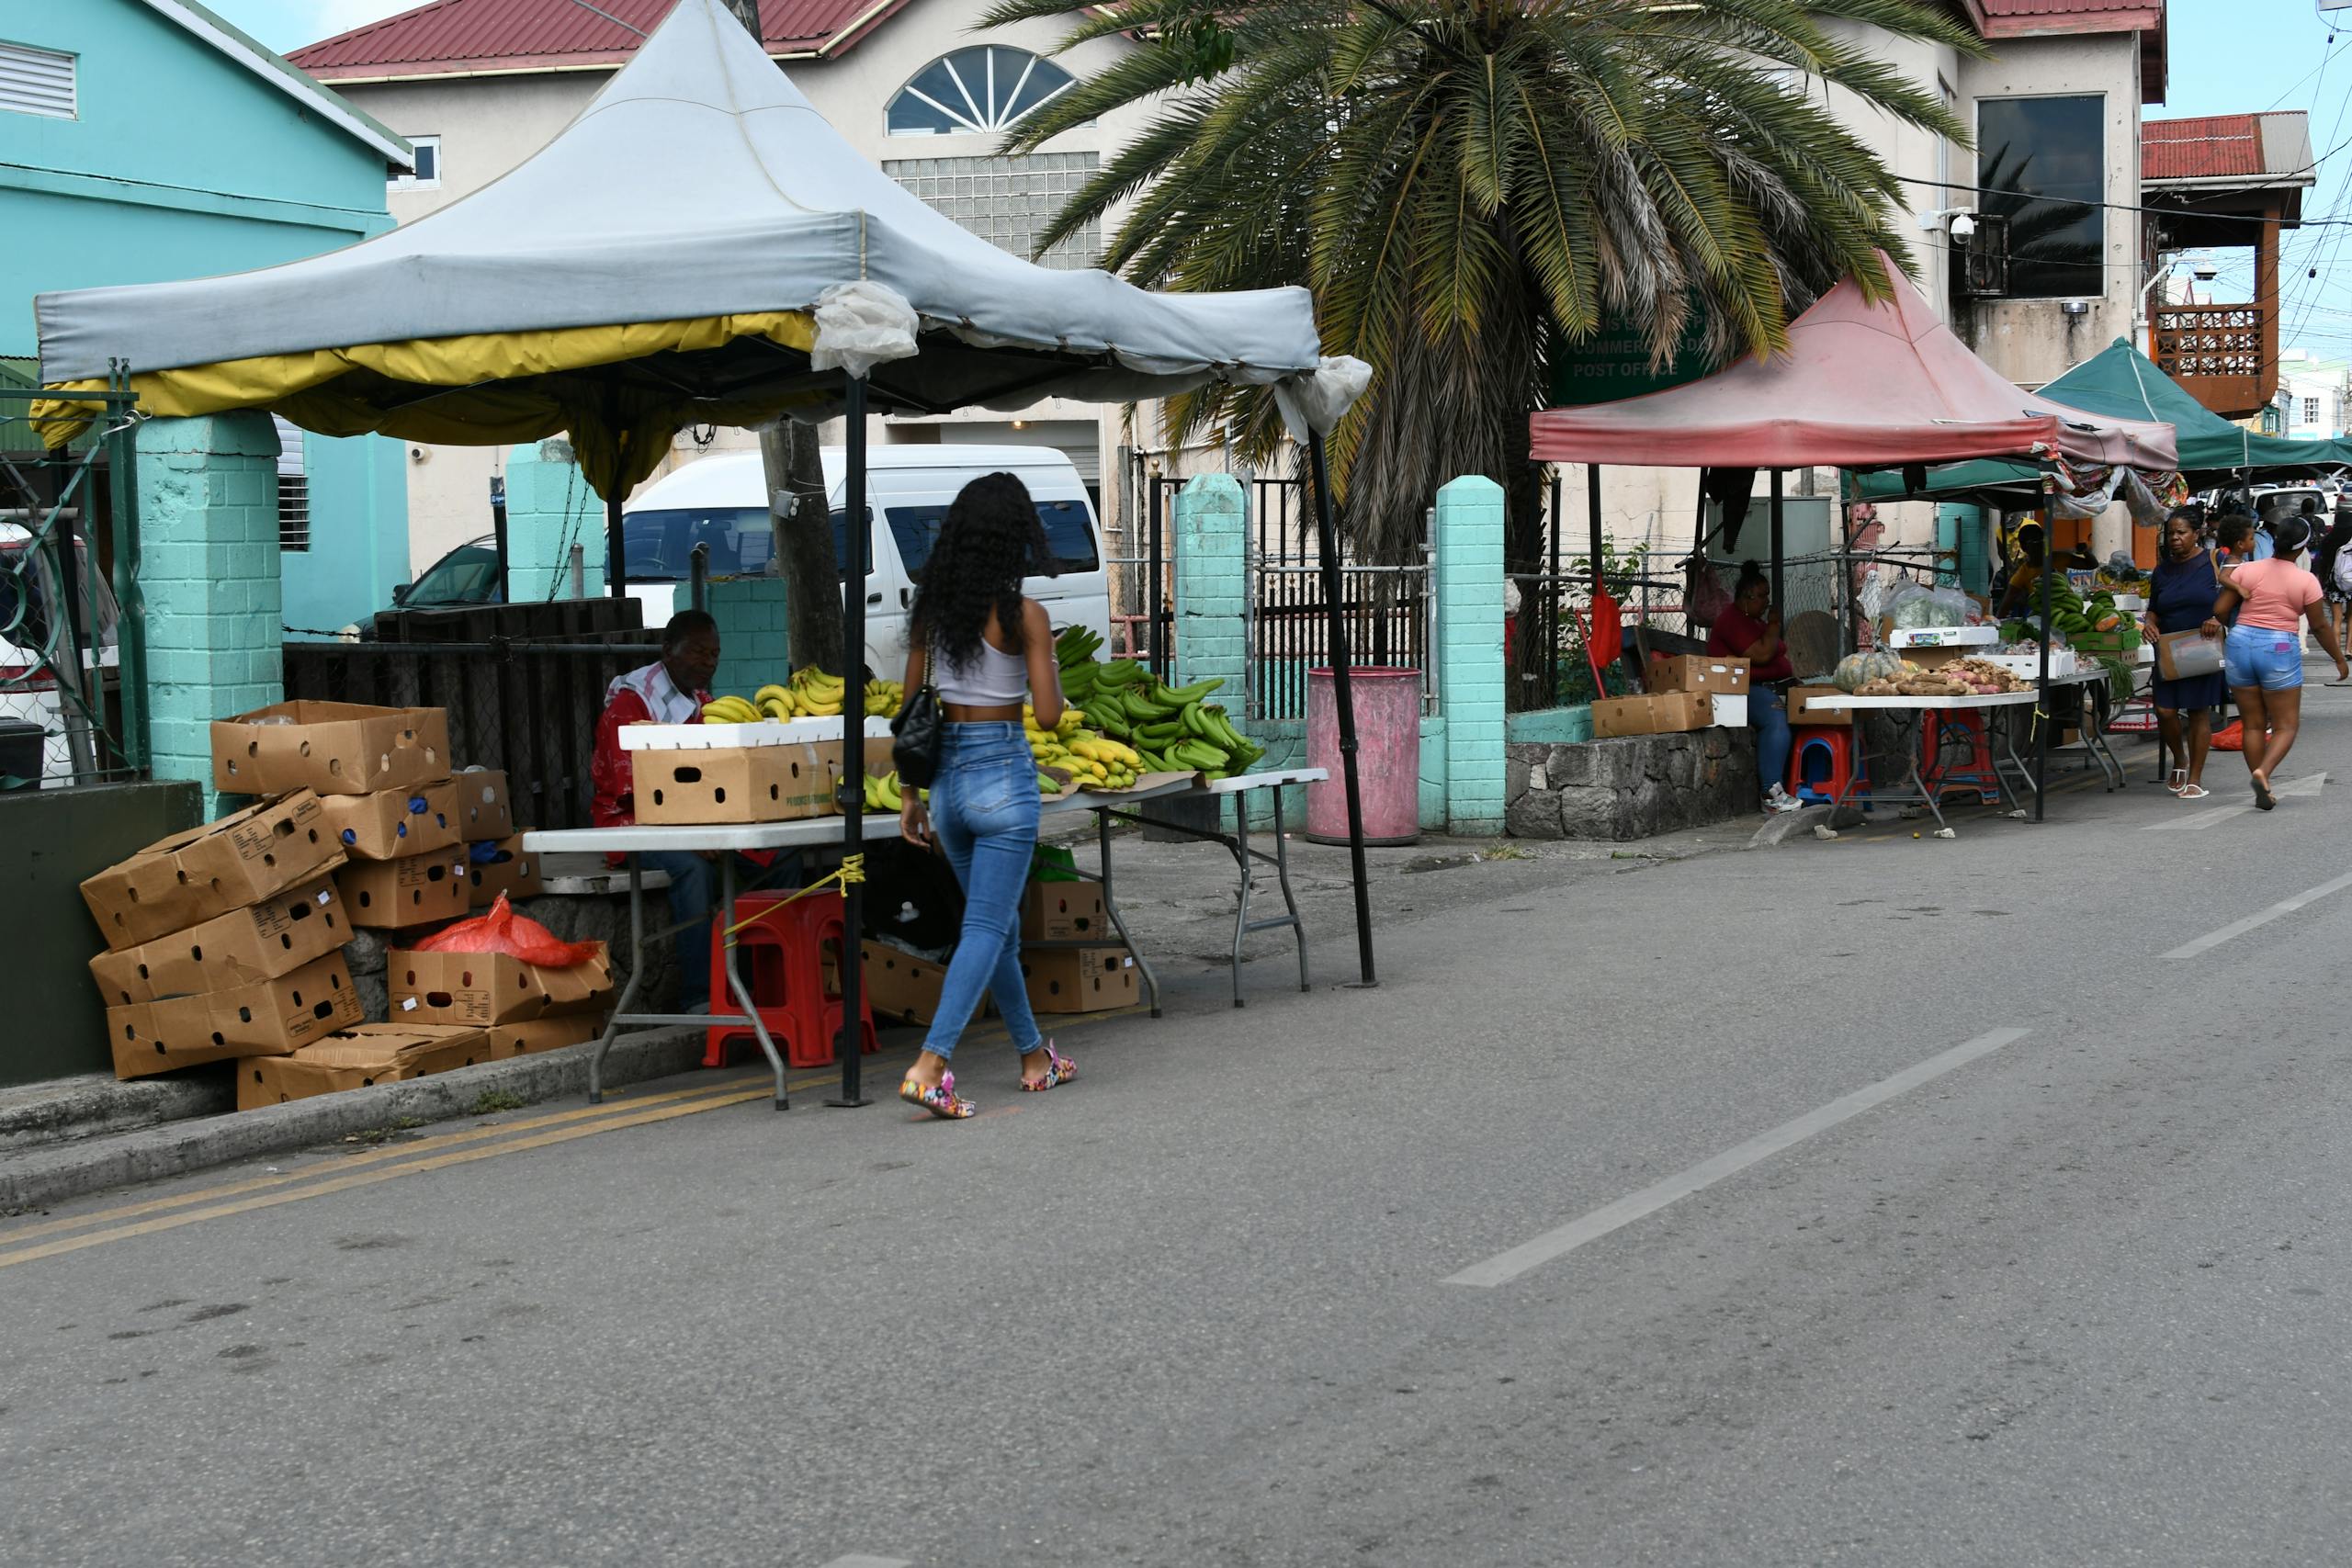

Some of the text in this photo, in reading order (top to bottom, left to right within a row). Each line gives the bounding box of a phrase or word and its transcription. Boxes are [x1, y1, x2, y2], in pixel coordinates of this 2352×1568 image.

[1573, 339, 1680, 355] COMMER
[1573, 361, 1679, 378] POST OFFCE
